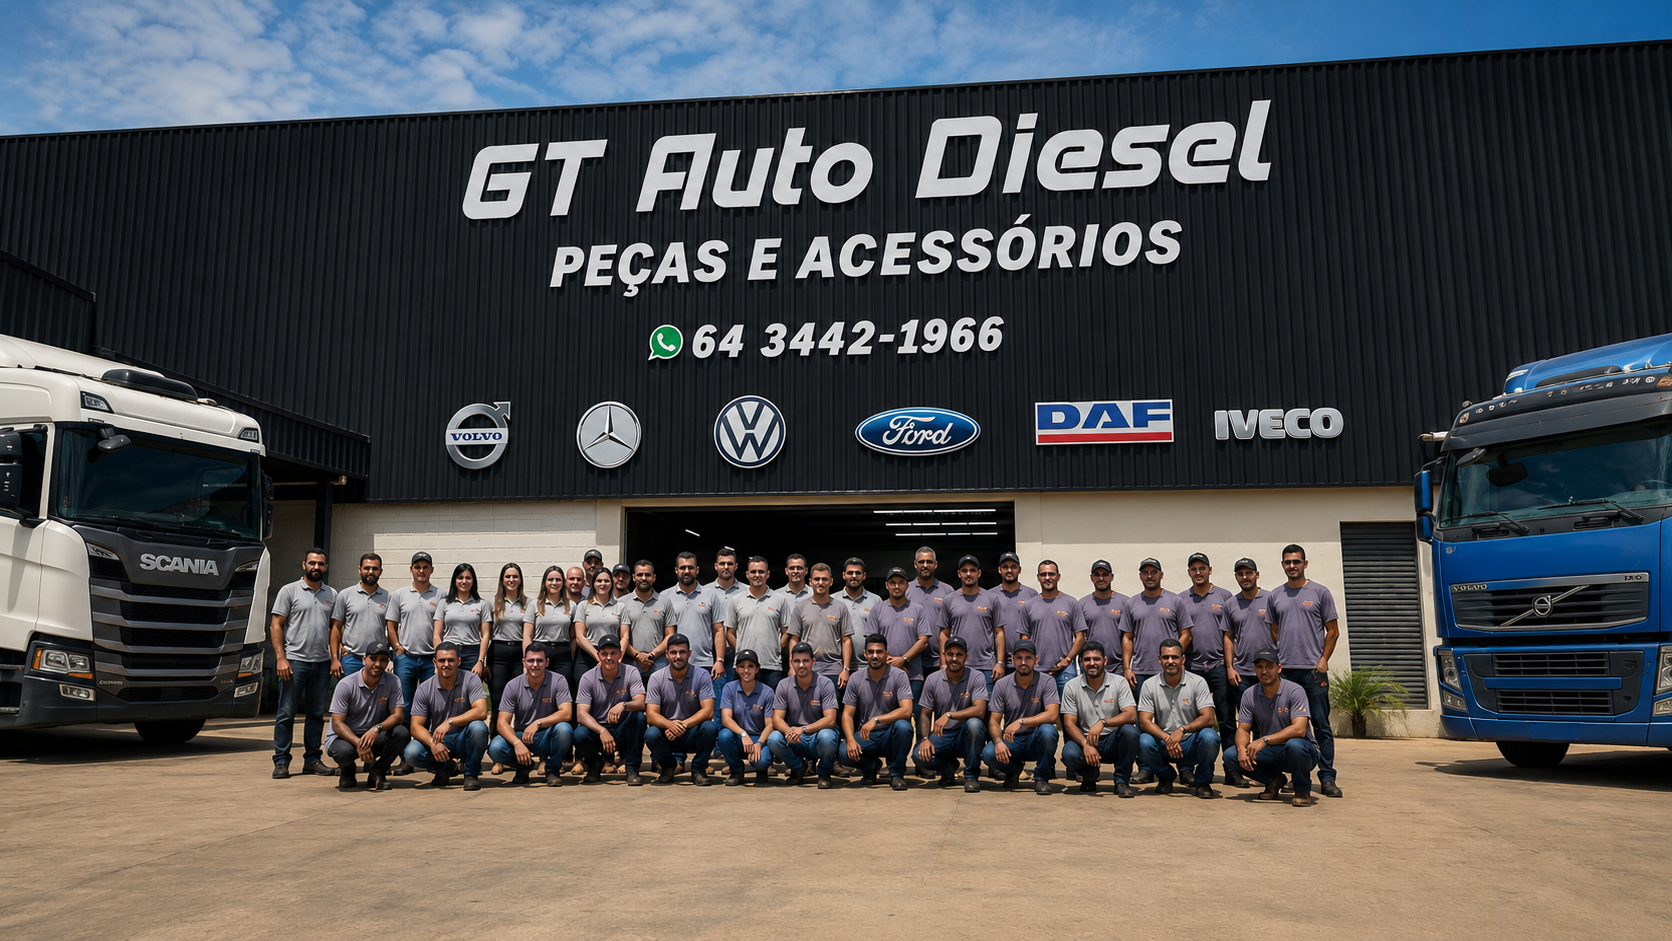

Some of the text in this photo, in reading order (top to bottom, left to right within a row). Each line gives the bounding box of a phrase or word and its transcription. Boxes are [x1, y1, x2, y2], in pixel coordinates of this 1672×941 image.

[462, 99, 1272, 220] GT Auto Diesel
[549, 213, 1183, 297] PEÇAS E ACESSÓRIOS
[692, 315, 1005, 359] 64 3442-1966
[882, 415, 954, 446] Ford
[1036, 401, 1172, 431] DAF
[1214, 406, 1345, 441] IVECO
[450, 431, 503, 441] VOLVO
[139, 552, 220, 577] SCANIA
